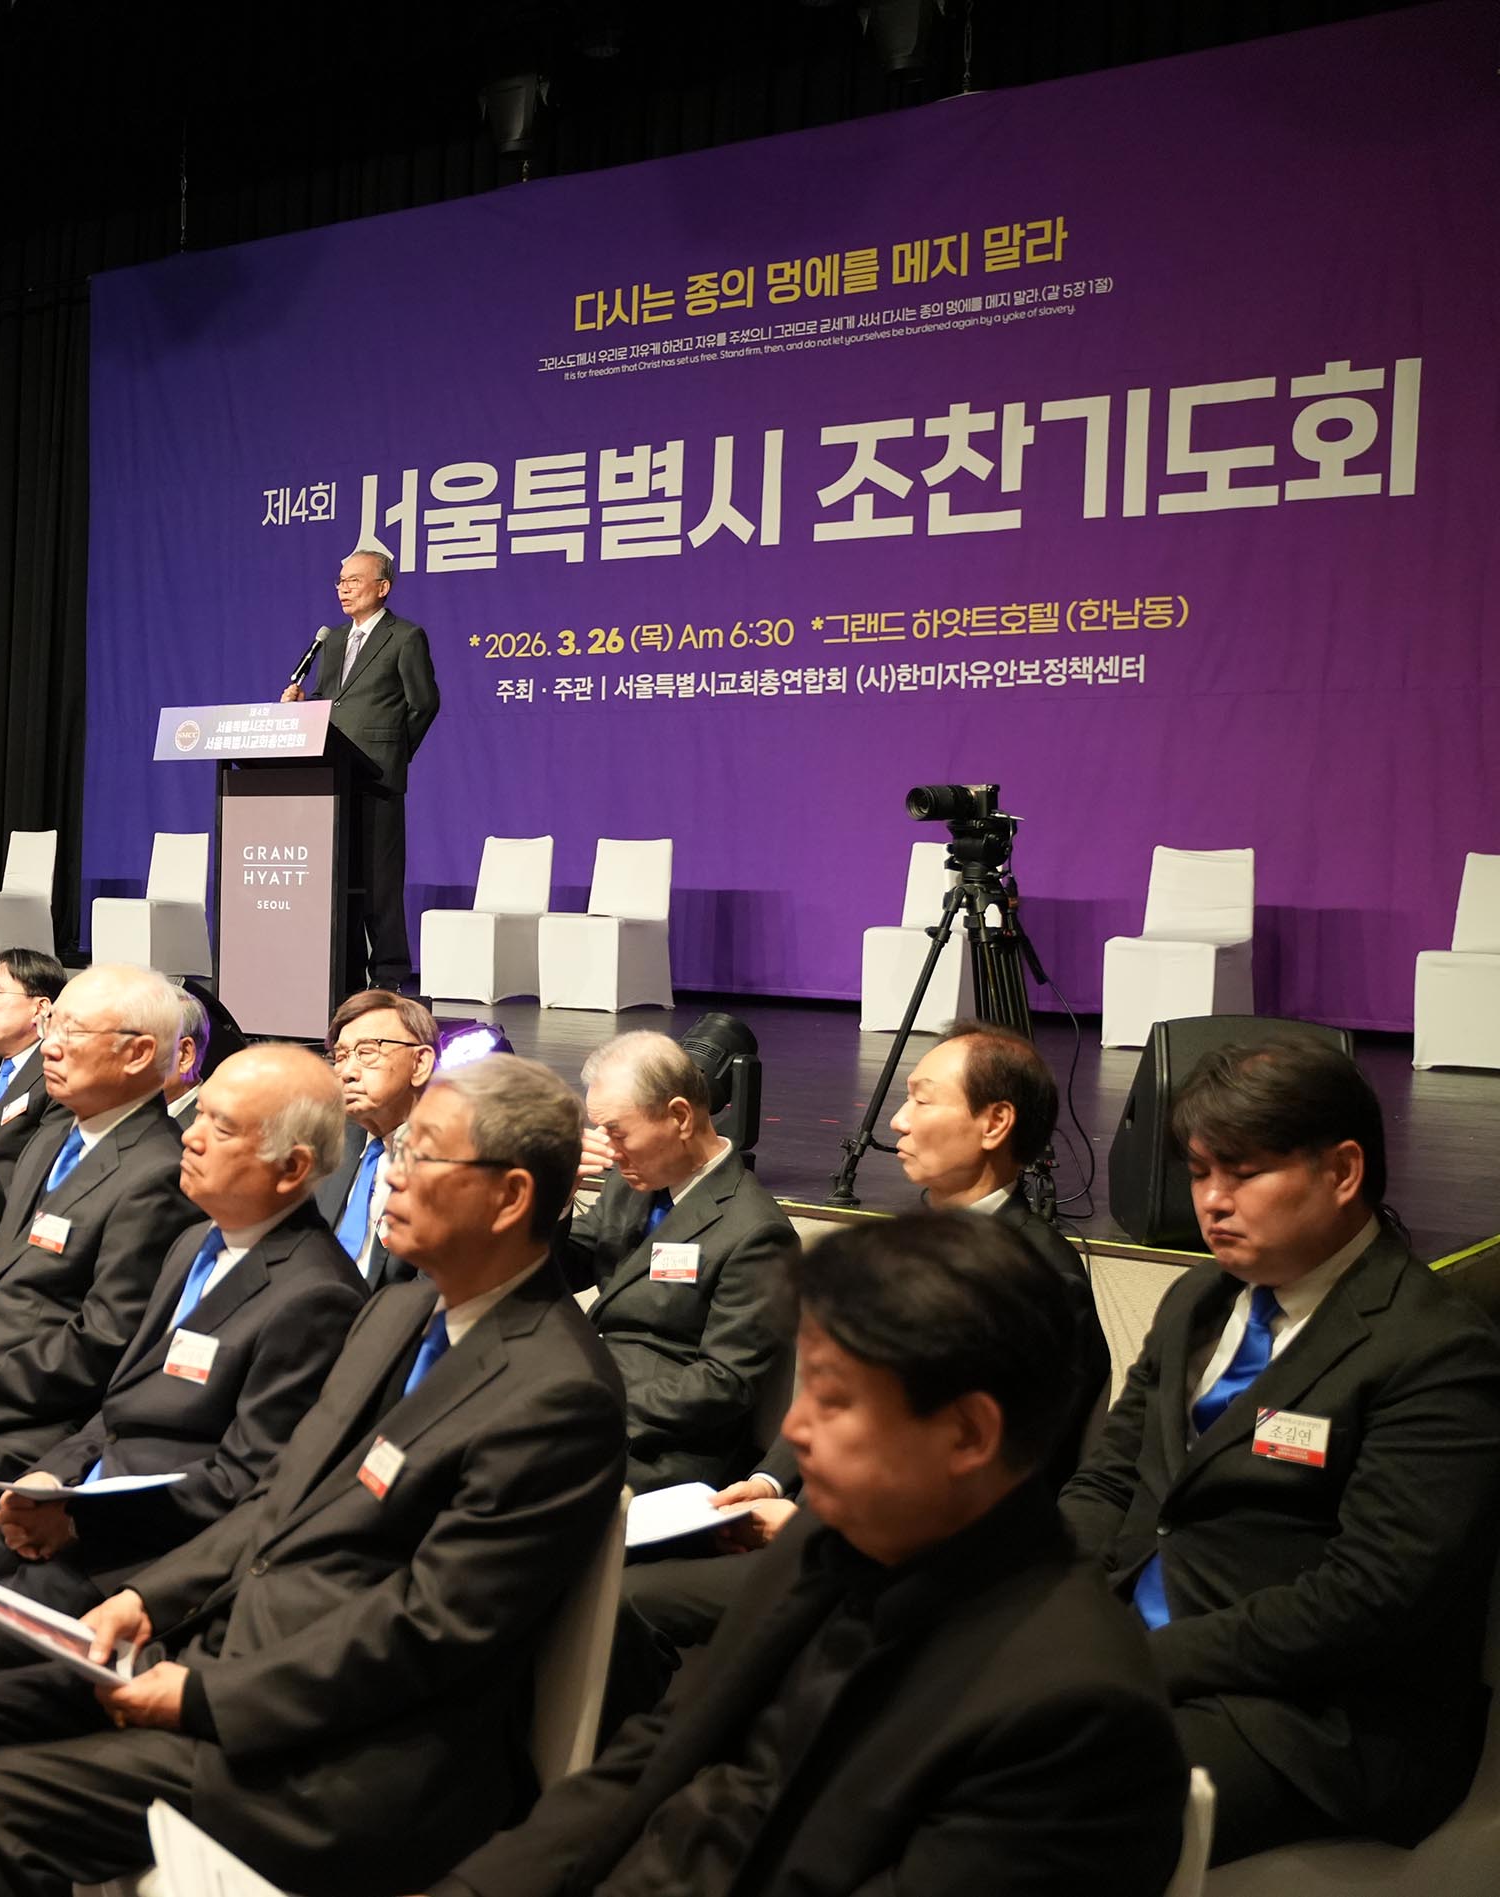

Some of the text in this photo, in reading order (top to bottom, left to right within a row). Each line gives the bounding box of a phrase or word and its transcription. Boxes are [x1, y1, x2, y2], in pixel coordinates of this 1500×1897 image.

[575, 216, 1068, 330] 다시는 종의 멍에를 메지 말라
[537, 350, 595, 372] 그리스도께서
[597, 346, 627, 364] 우리로
[661, 337, 692, 355] 하려고
[694, 332, 726, 350] 자유를
[728, 326, 772, 346] 주셨으니
[773, 319, 817, 339] 그러므로
[819, 314, 854, 333] 굳세게
[856, 311, 880, 328] 서서
[882, 306, 916, 324] 다시는
[919, 301, 942, 319] 종의
[945, 296, 982, 315] 멍에를
[985, 292, 1010, 310] 메지
[576, 369, 587, 379] for
[588, 365, 620, 377] freedom
[620, 362, 638, 373] that
[637, 359, 660, 371] Christ
[660, 357, 675, 367] has
[676, 355, 688, 365] set
[700, 351, 718, 362] free.
[719, 347, 744, 359] Stand
[763, 342, 785, 356] then,
[786, 340, 804, 351] and
[804, 338, 815, 348] do
[817, 336, 832, 346] not
[832, 334, 844, 344] let
[844, 328, 891, 345] yourselves
[891, 326, 904, 336] be
[905, 319, 950, 334] burdened
[951, 318, 978, 330] again
[979, 313, 992, 326] by
[1002, 309, 1025, 323] yoke
[1026, 307, 1036, 317] of
[1038, 302, 1076, 318] slavery.
[262, 357, 1423, 573] 제4회 서울특별시 조찬기도회
[557, 630, 582, 656] 3.
[587, 627, 624, 655] 26
[630, 623, 673, 653] (목)
[678, 624, 723, 650] Am
[729, 618, 795, 648] 6:30
[912, 602, 1060, 640] 하얏트호텔
[1066, 595, 1189, 632] (한남동)
[496, 678, 534, 703] 주최
[553, 676, 594, 702] 주관
[614, 666, 847, 699] 서울특별시교회총연합회
[856, 653, 1146, 694] (사)한미자유안보정책센터
[243, 846, 308, 861] GRAND
[243, 871, 304, 886] HYATT
[257, 900, 291, 910] SEOUL
